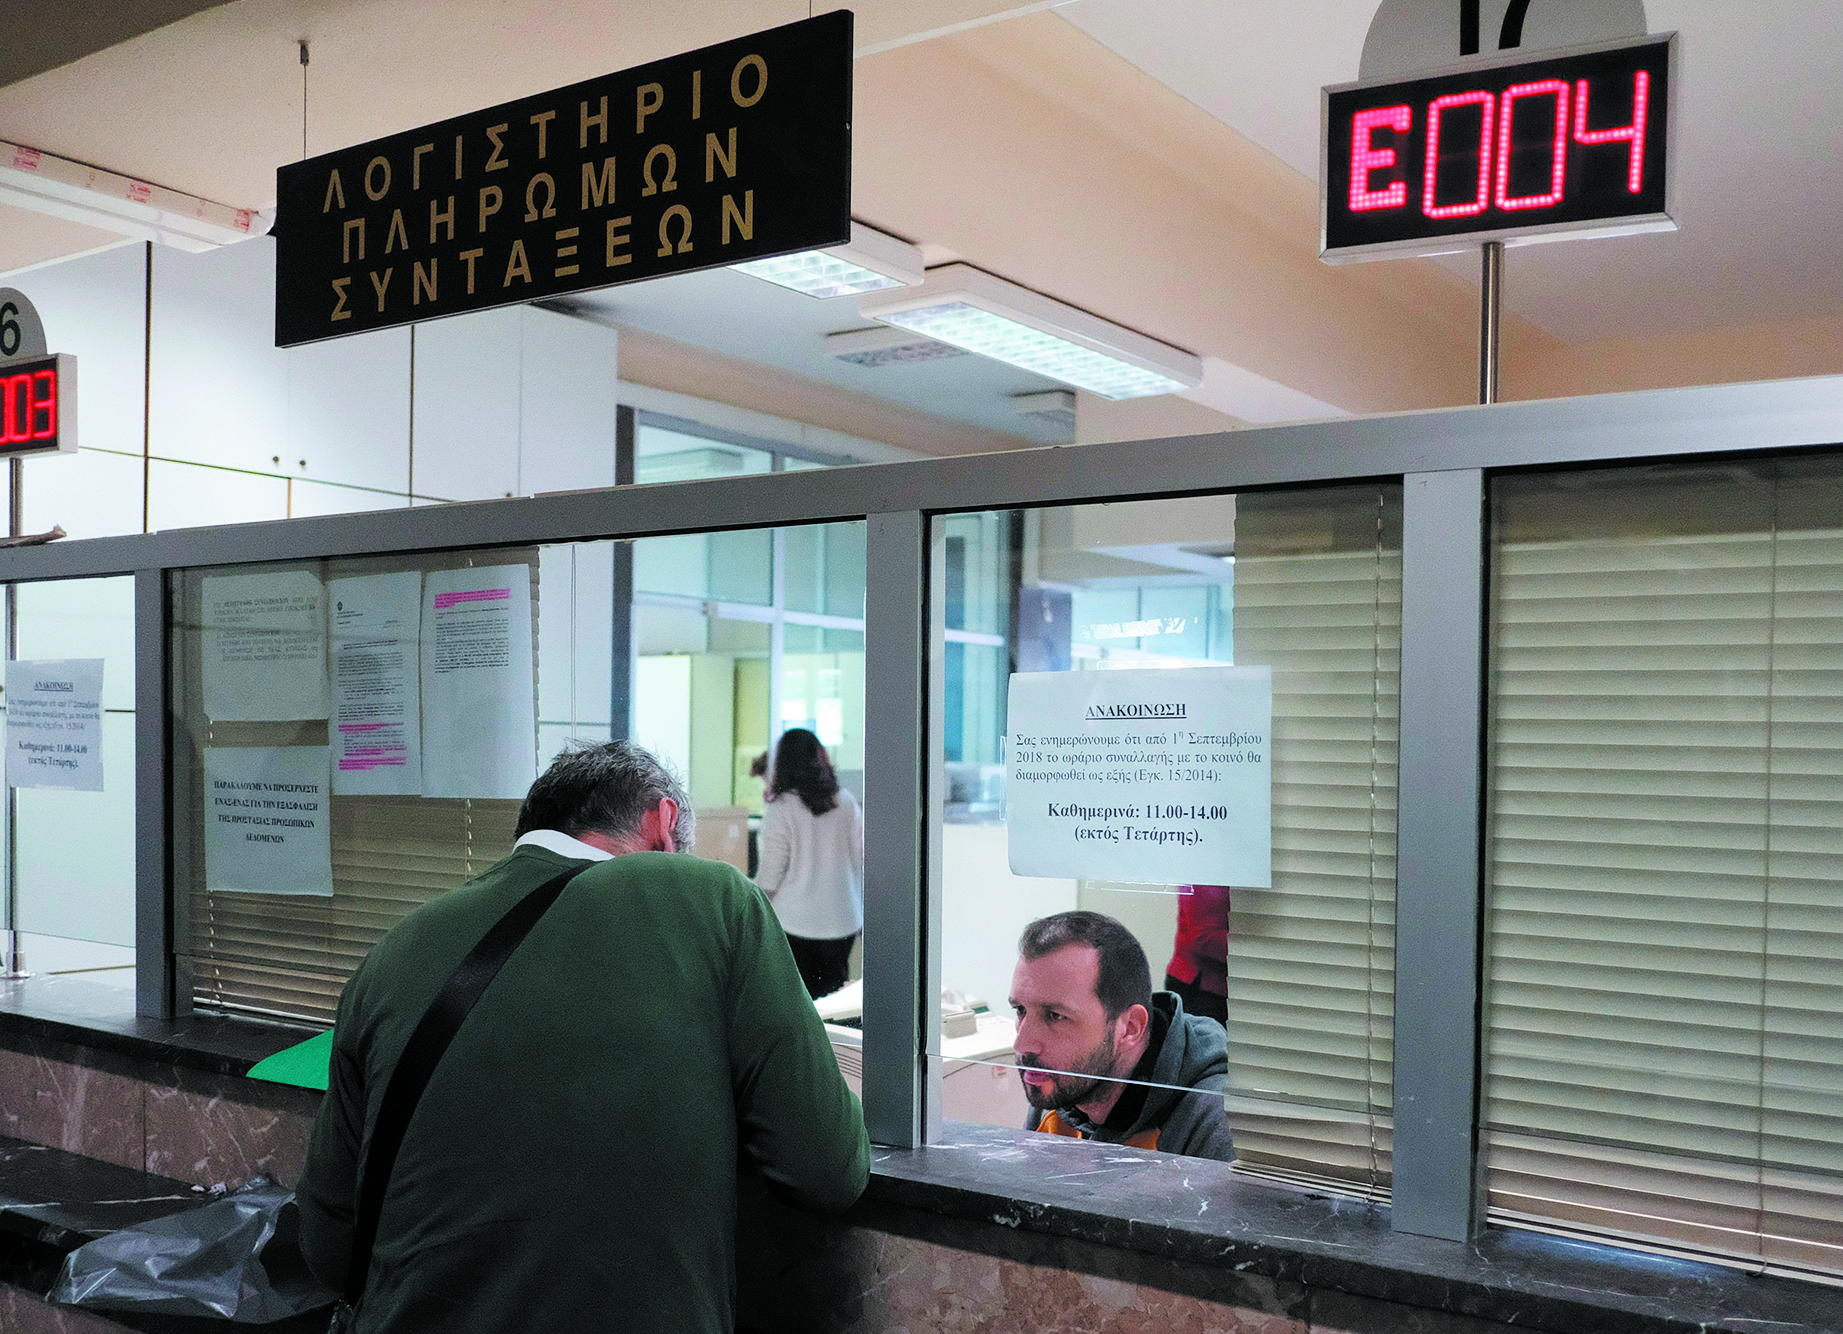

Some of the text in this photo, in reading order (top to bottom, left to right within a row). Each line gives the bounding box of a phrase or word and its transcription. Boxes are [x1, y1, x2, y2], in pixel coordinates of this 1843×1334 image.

[322, 53, 768, 213] ΛΟΓΙΣΤΗΡΙΟ
[342, 127, 737, 264] ΠΛΗΡΩΜΩΝ
[330, 189, 754, 322] ΣΥΝΤΑΞΕΩΝ
[1085, 703, 1187, 719] ΑΝΑΚΟΙΝΩΣΗ
[1016, 733, 1036, 747] Σας
[1040, 733, 1120, 747] ενημερώνουμε
[1124, 732, 1142, 745] ότι
[1146, 732, 1167, 747] από
[1188, 731, 1262, 748] Σεπτεμβρίου
[1016, 750, 1262, 766] 2018 το ωράριο συναλλαγής με το κοινό θα
[1016, 768, 1222, 784] διαμορφωθεί ως εξής (Εγκ. 15/2014):
[1048, 803, 1228, 822] Καθημερινά: 11.00-14.00
[1074, 824, 1203, 846] (εκτός Τετάρτης).
